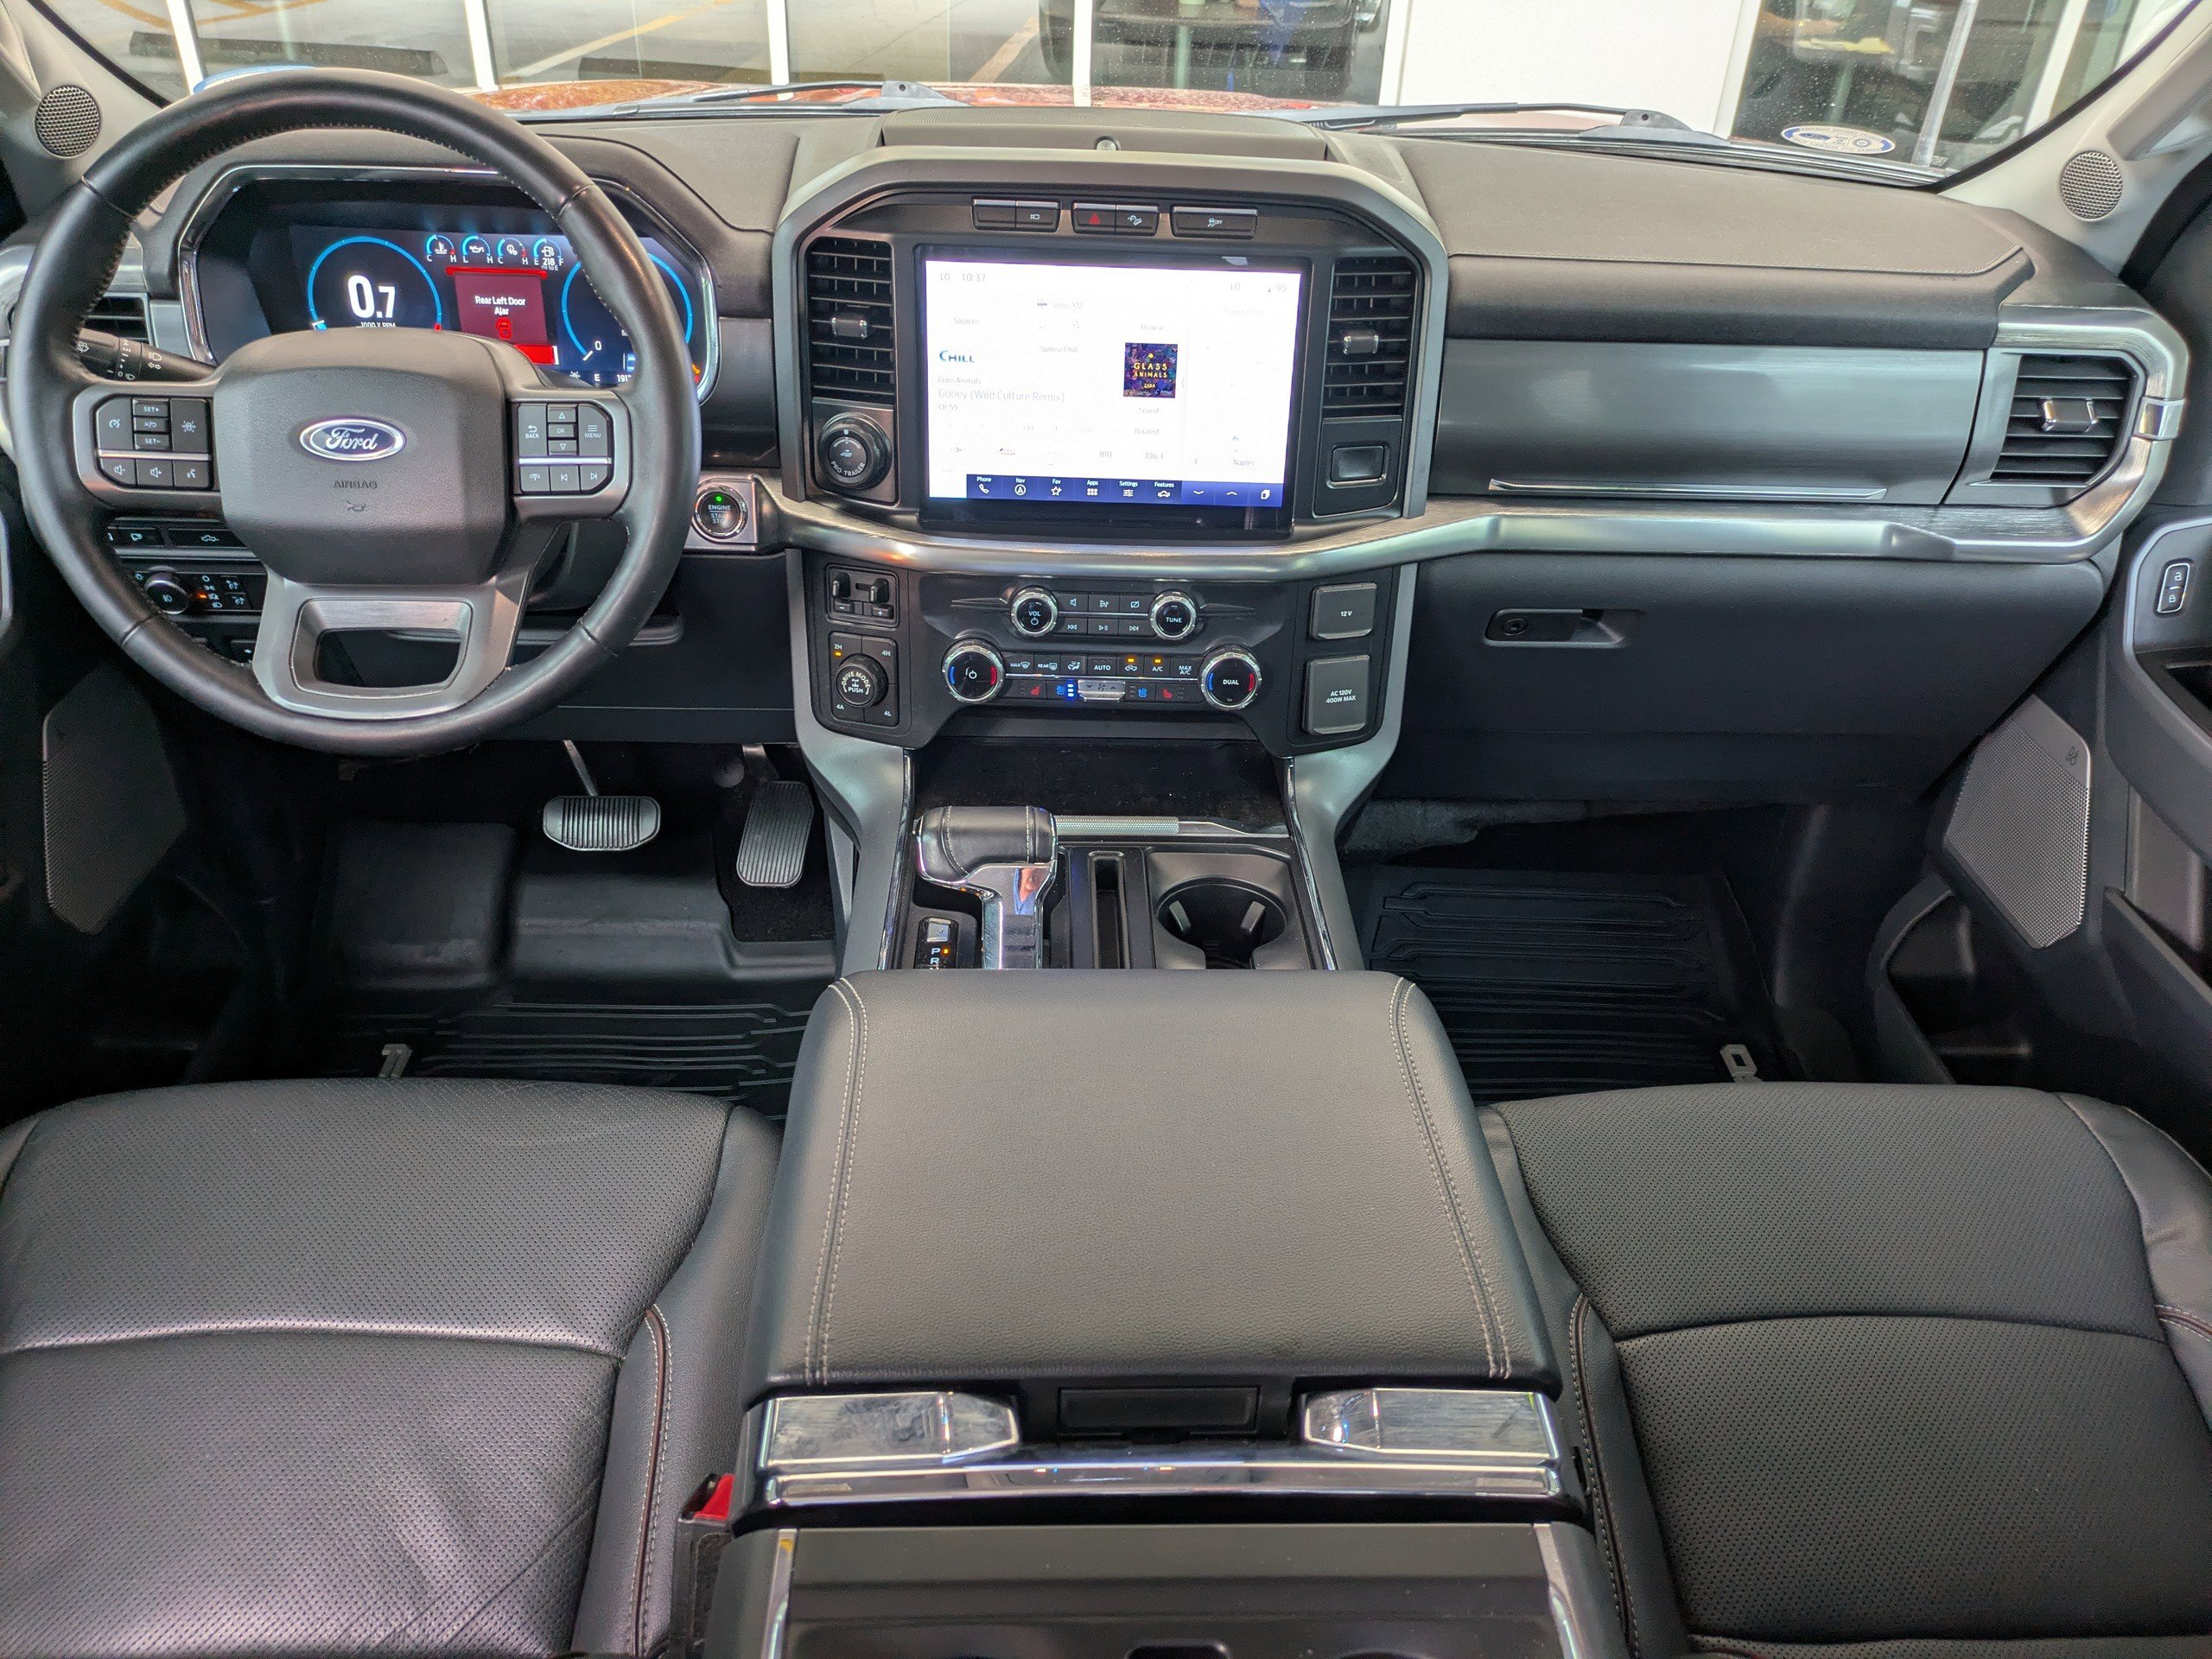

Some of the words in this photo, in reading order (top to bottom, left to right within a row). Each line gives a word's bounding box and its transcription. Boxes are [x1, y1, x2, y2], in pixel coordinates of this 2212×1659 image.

[542, 257, 556, 266] 218
[940, 272, 950, 281] LO
[961, 272, 987, 283] 10:37
[1230, 283, 1241, 291] LO
[347, 275, 396, 319] 0.7
[474, 296, 492, 305] Rear
[493, 296, 508, 305] Left
[508, 296, 526, 306] Door
[494, 307, 510, 316] Ajar
[953, 316, 980, 326] Sources
[594, 340, 602, 351] 0
[1039, 345, 1064, 353] Sunrise
[1134, 362, 1167, 371] GLASS
[594, 373, 601, 382] E
[616, 373, 632, 383] 191
[957, 376, 982, 385] Animals
[938, 388, 968, 400] Gooey
[969, 389, 995, 401] (Wild
[997, 390, 1031, 401] Culture
[1032, 391, 1065, 404] Remix)
[325, 426, 379, 450] Ford
[1233, 459, 1255, 467] Naples
[830, 461, 842, 474] PRO
[843, 462, 866, 477] TRAILER
[333, 480, 378, 489] AIRBAG
[841, 671, 855, 686] DRIVE
[855, 671, 871, 688] MODE
